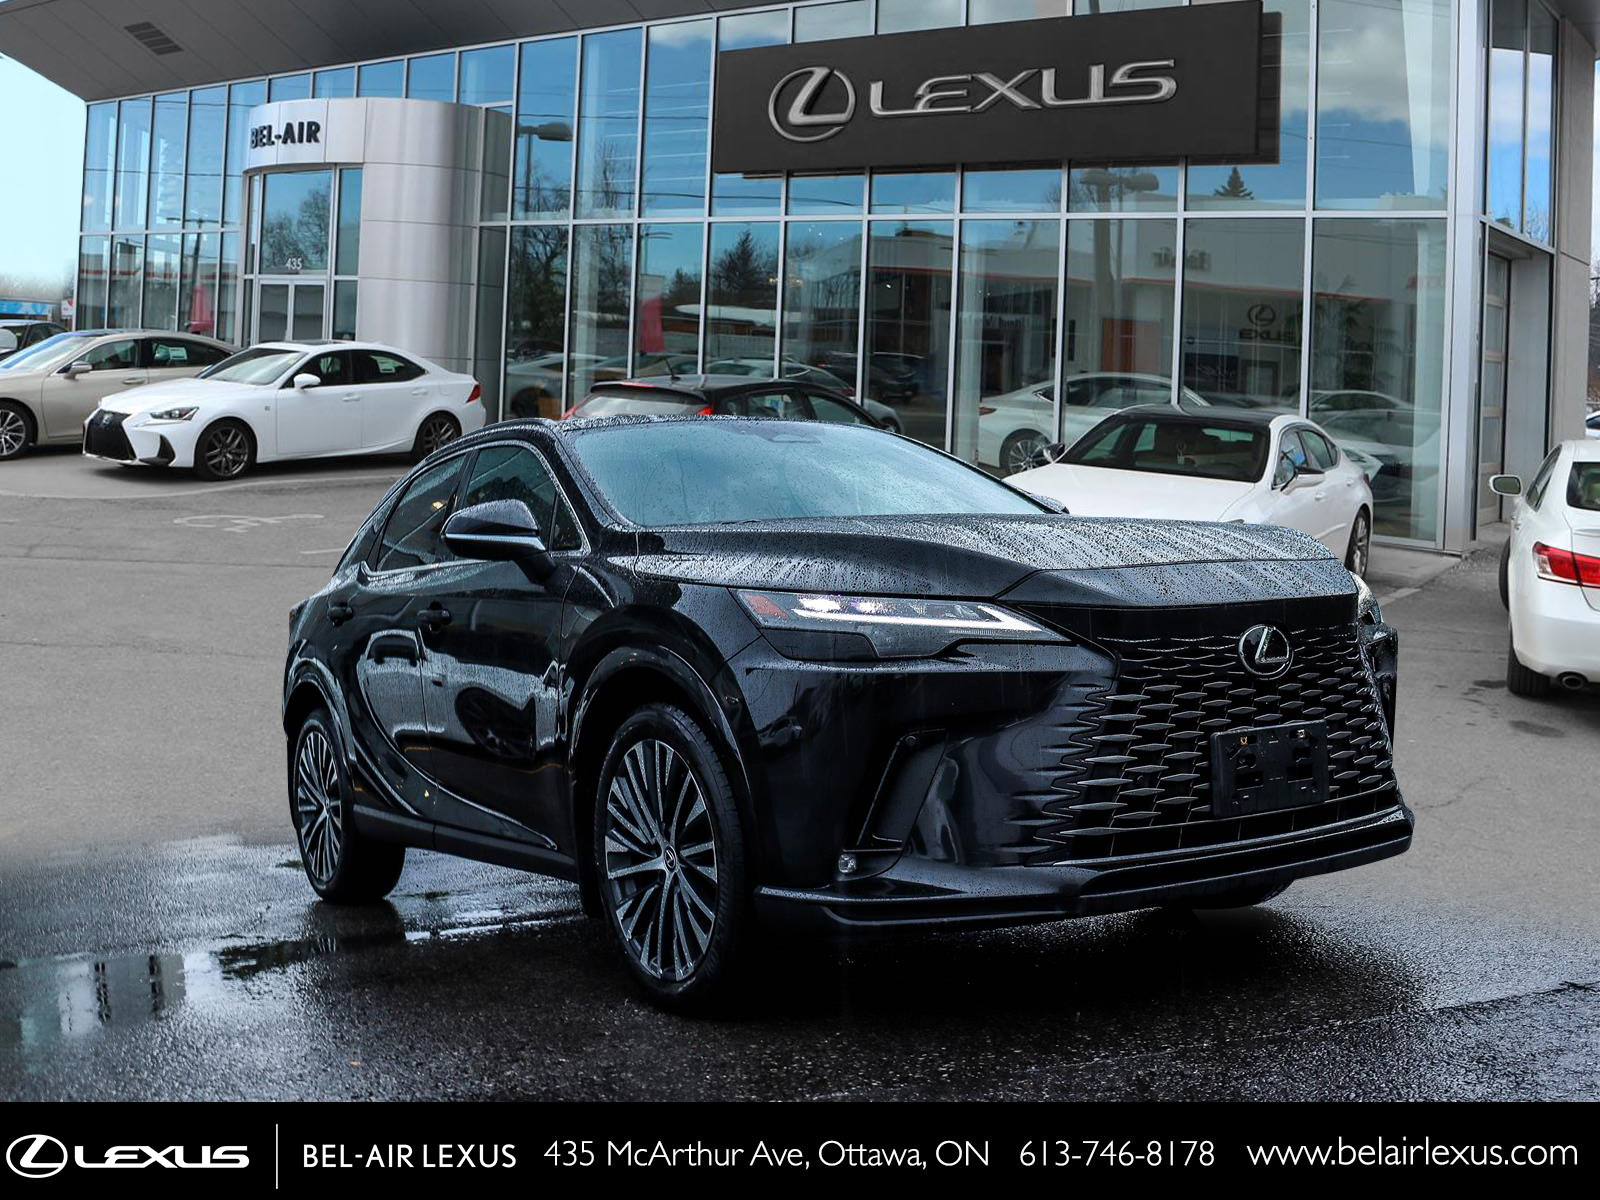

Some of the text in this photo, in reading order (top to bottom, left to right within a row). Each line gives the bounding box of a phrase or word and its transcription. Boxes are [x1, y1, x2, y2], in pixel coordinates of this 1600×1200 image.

[869, 59, 1178, 118] LEXUS
[250, 121, 321, 149] BEL-AIR
[285, 257, 302, 270] 435
